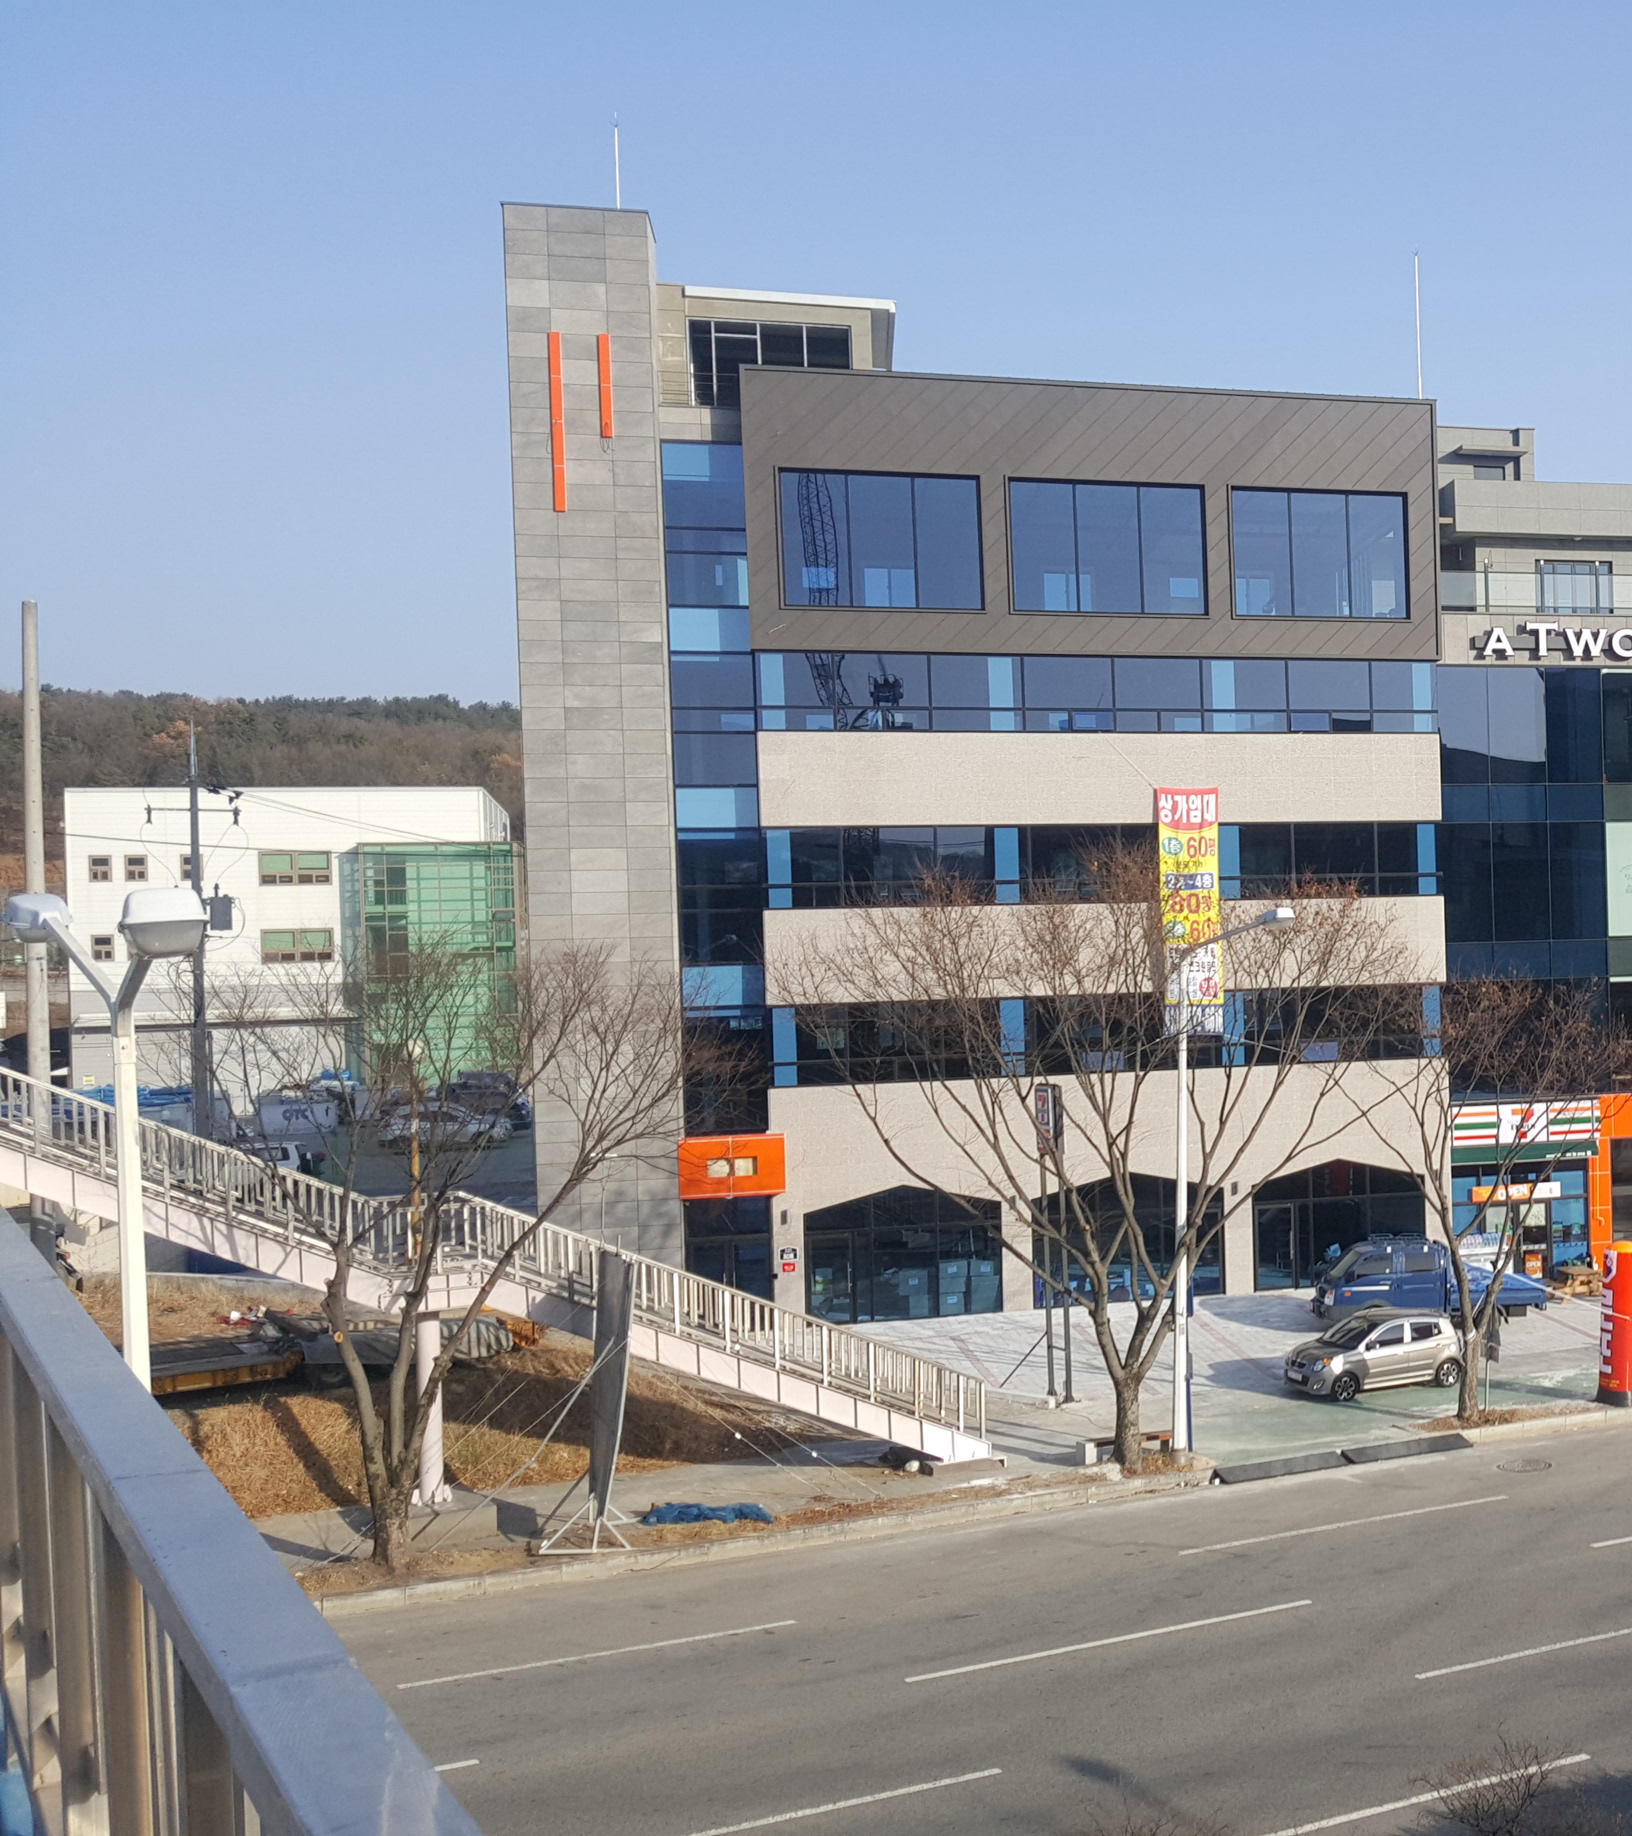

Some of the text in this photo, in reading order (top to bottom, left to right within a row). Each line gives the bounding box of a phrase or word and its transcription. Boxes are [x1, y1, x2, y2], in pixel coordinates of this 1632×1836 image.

[1483, 627, 1515, 657] A
[1159, 793, 1217, 823] 상가임대
[1163, 836, 1216, 859] 1층 60평
